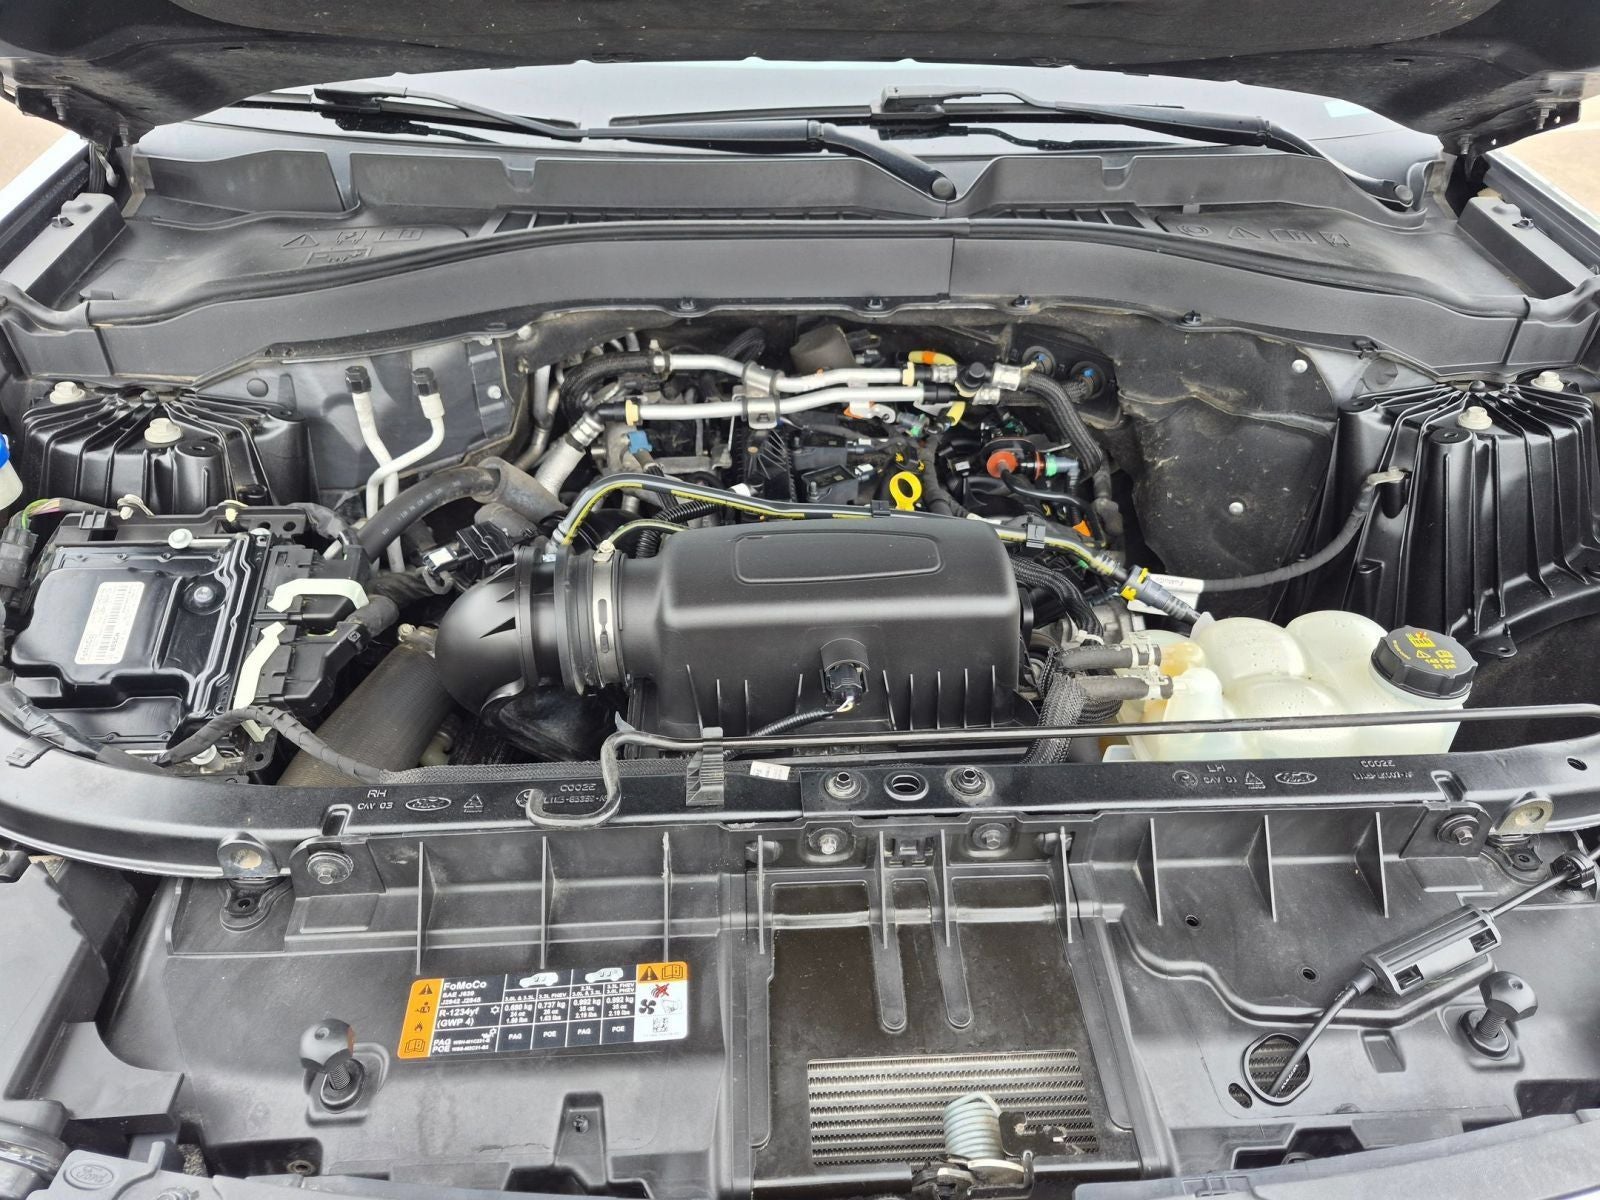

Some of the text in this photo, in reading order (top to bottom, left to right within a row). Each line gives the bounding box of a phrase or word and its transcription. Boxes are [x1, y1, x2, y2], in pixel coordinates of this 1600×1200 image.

[1207, 764, 1226, 772] LH
[368, 790, 387, 798] RH
[443, 980, 487, 991] FoMoCo
[557, 1001, 566, 1009] kg
[592, 998, 601, 1006] kg
[439, 1007, 479, 1017] R-1234yf
[437, 1018, 474, 1028] (GWP 4)
[433, 1038, 451, 1046] PAG
[432, 1045, 450, 1053] POE
